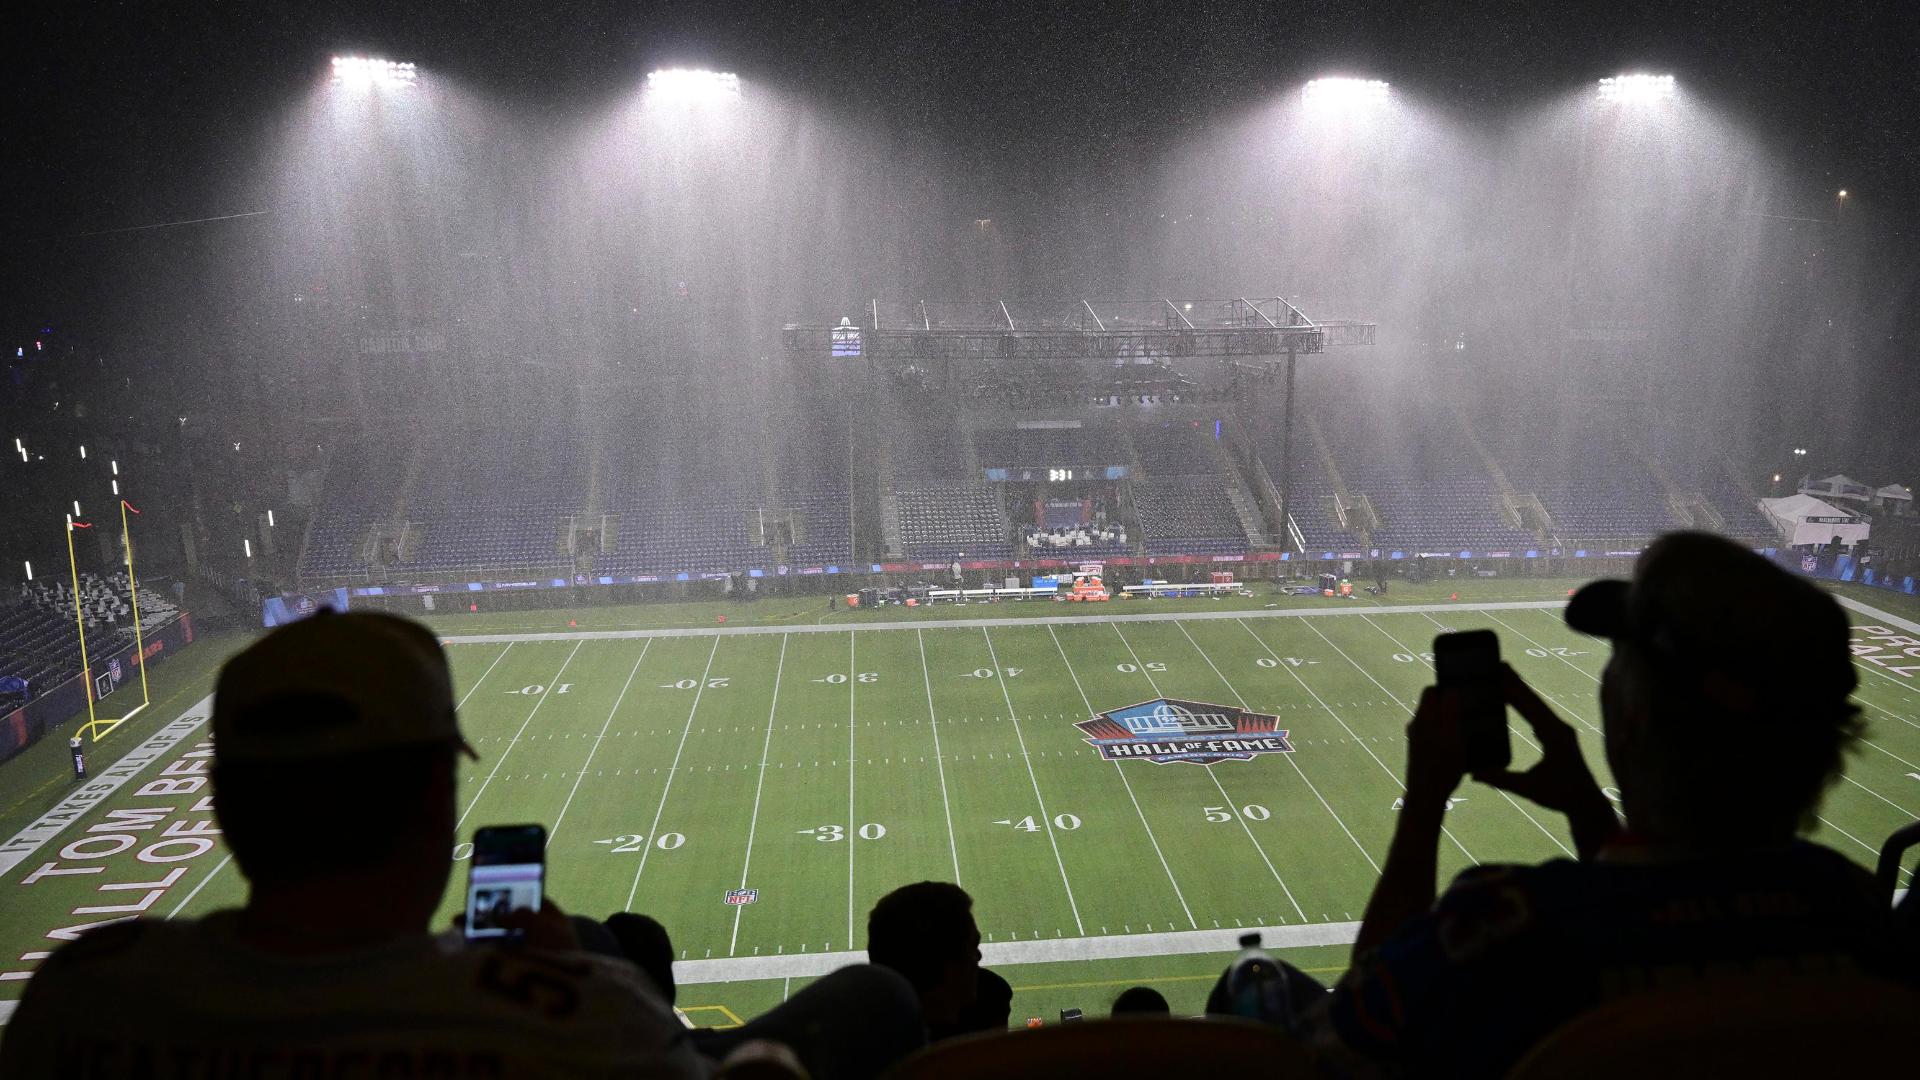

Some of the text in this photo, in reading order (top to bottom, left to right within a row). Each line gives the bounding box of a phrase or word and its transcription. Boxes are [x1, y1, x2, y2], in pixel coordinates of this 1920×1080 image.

[1110, 738, 1282, 756] HALL OF FAME
[0, 716, 204, 852] IT TAKES ALL OF US
[1013, 813, 1082, 833] 40
[1203, 804, 1271, 823] 50
[609, 831, 687, 853] 20
[815, 822, 887, 842] 30
[20, 807, 177, 885] TOM
[453, 842, 474, 861] 0
